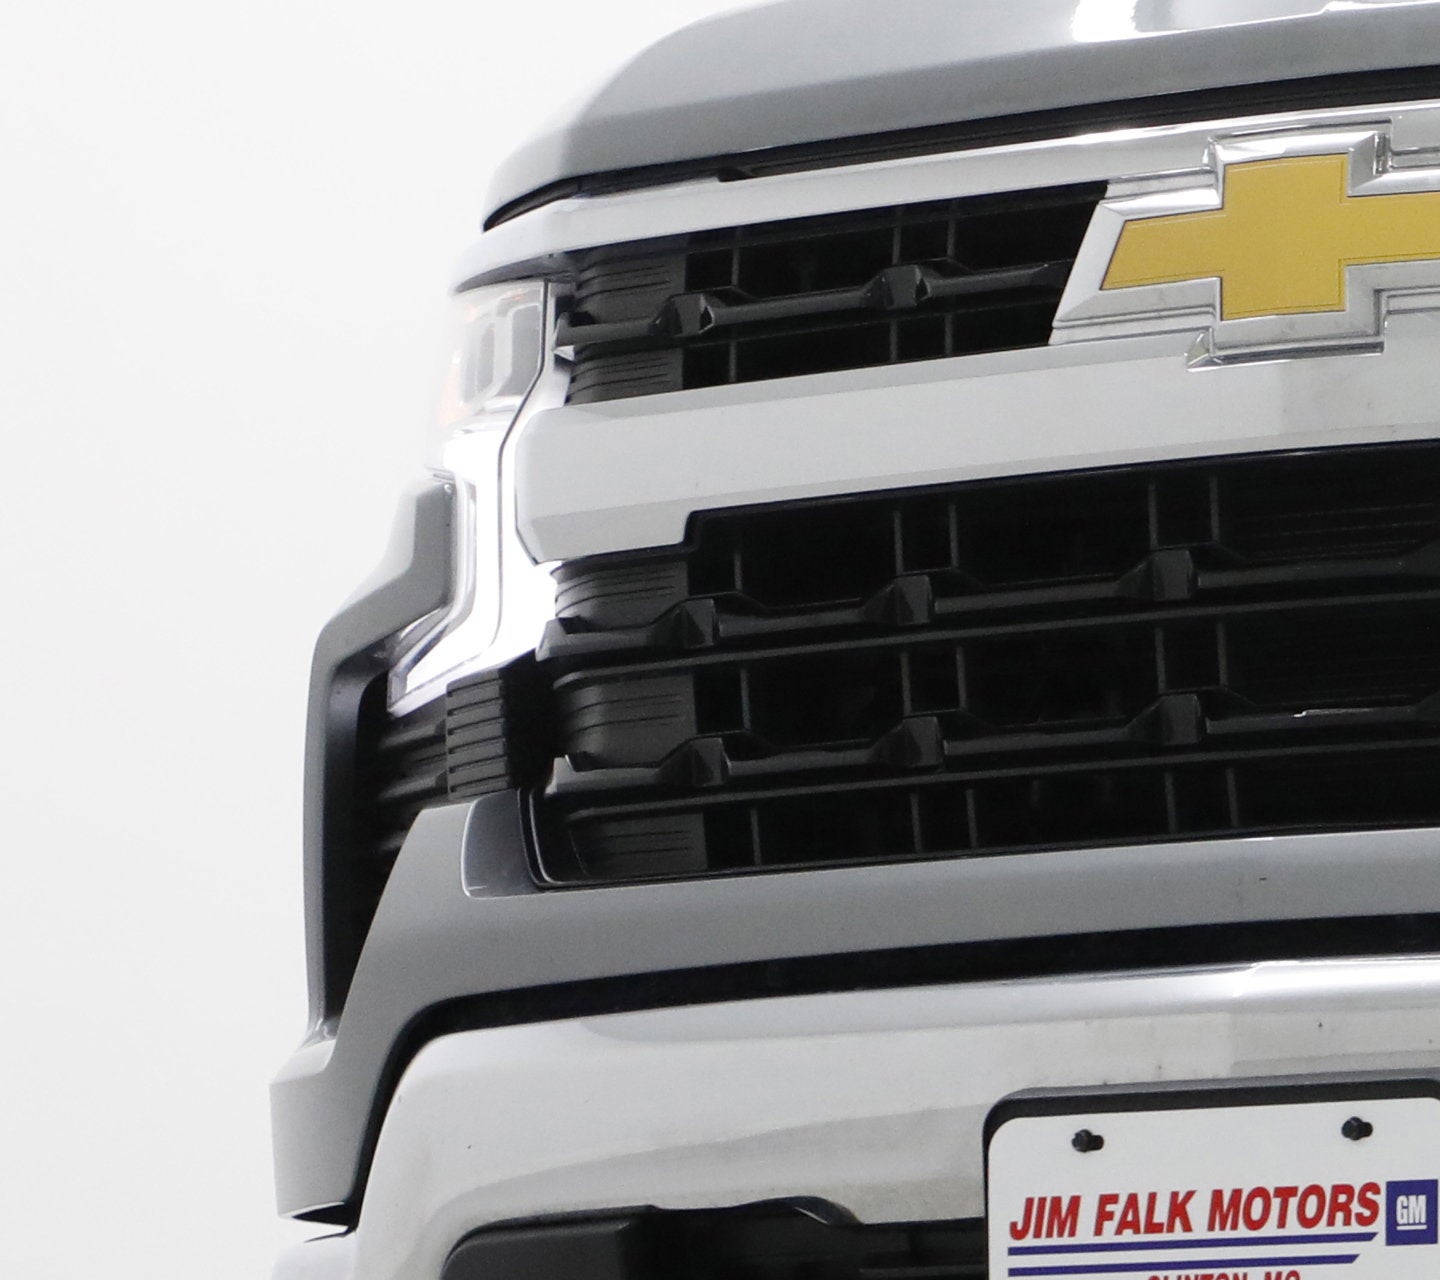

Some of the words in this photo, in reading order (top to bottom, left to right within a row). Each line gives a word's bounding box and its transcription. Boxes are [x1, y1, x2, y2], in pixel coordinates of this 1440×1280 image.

[1008, 1195, 1082, 1242] JIM
[1093, 1189, 1197, 1237] FALK
[1206, 1181, 1382, 1233] MOTORS
[1395, 1193, 1428, 1225] GM
